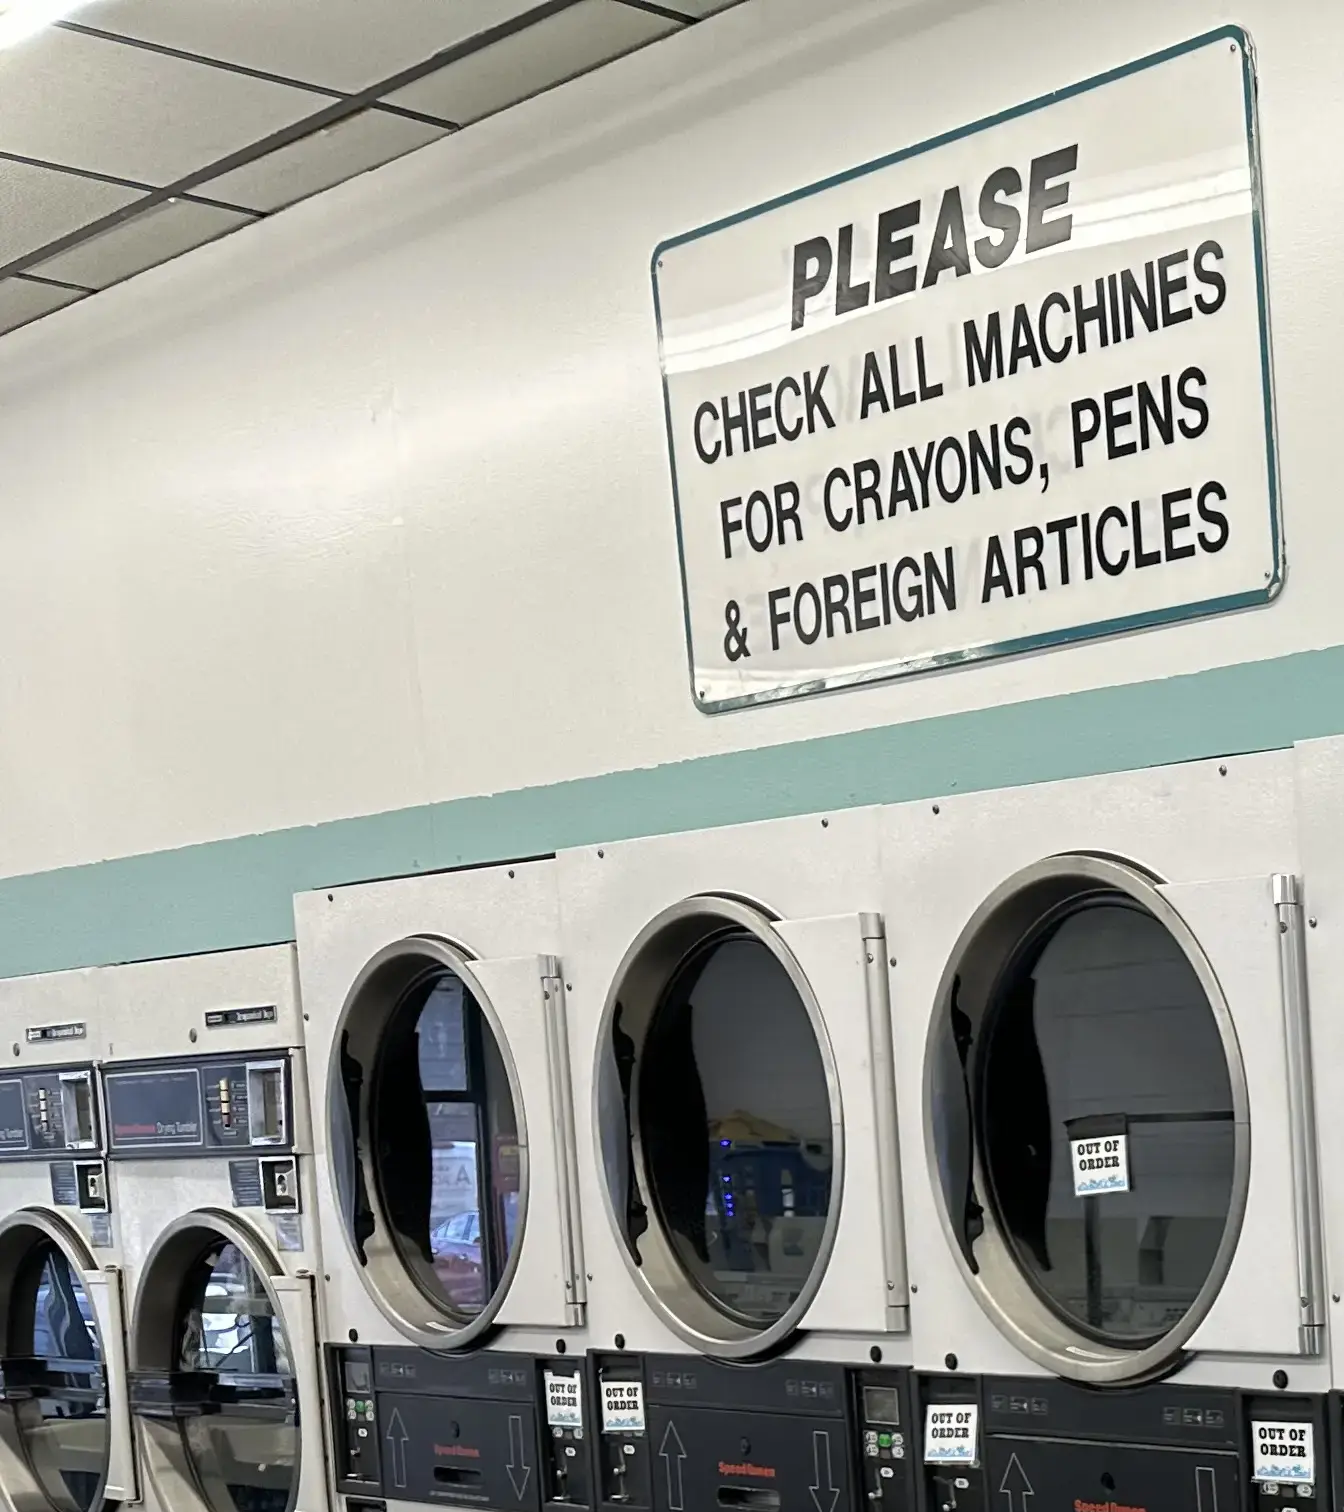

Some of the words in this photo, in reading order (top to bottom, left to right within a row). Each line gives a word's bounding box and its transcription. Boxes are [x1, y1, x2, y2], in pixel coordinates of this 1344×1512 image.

[791, 144, 1078, 330] PLEASE
[694, 364, 836, 465] CHECK
[860, 336, 944, 419] ALL
[964, 239, 1227, 387] MACHINES
[719, 480, 803, 559] FOR
[824, 416, 1049, 532] CRAYONS,
[1072, 366, 1210, 469] PENS
[723, 599, 751, 662] &
[769, 547, 956, 651] FOREIGN
[981, 481, 1230, 604] ARTICLES
[1077, 1142, 1101, 1155] OUT
[1104, 1140, 1119, 1152] OF
[1079, 1156, 1119, 1171] ORDER
[550, 1383, 565, 1393] OUT
[567, 1384, 577, 1394] OF
[606, 1388, 624, 1397] OUT
[627, 1387, 638, 1397] OF
[550, 1396, 577, 1406] ORDER
[607, 1400, 638, 1410] ORDER
[932, 1413, 953, 1423] OUT
[956, 1413, 971, 1423] OF
[932, 1428, 969, 1438] ORDER
[1259, 1428, 1285, 1440] OUT
[1289, 1429, 1306, 1441] OF
[1260, 1444, 1306, 1458] ORDER
